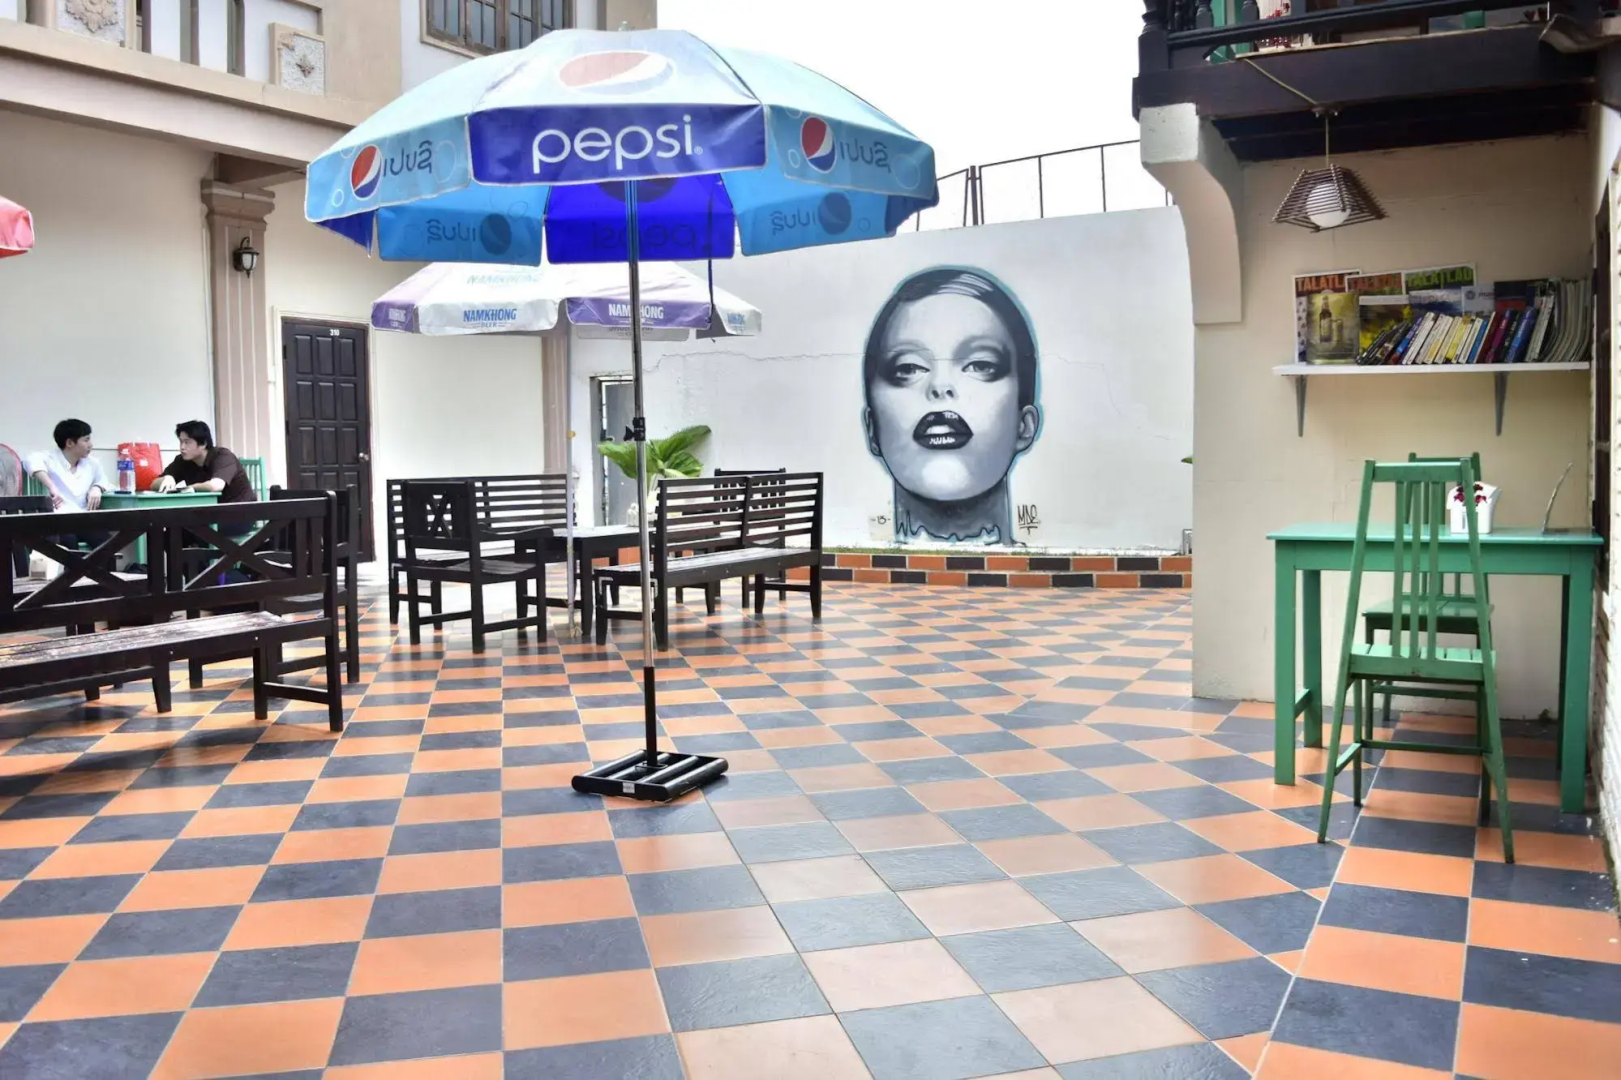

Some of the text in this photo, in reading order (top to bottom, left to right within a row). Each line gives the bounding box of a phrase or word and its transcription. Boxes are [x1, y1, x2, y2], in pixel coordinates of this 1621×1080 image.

[532, 114, 692, 174] pepsi
[463, 308, 517, 322] NAMKHONG
[608, 303, 664, 319] NAMHONG
